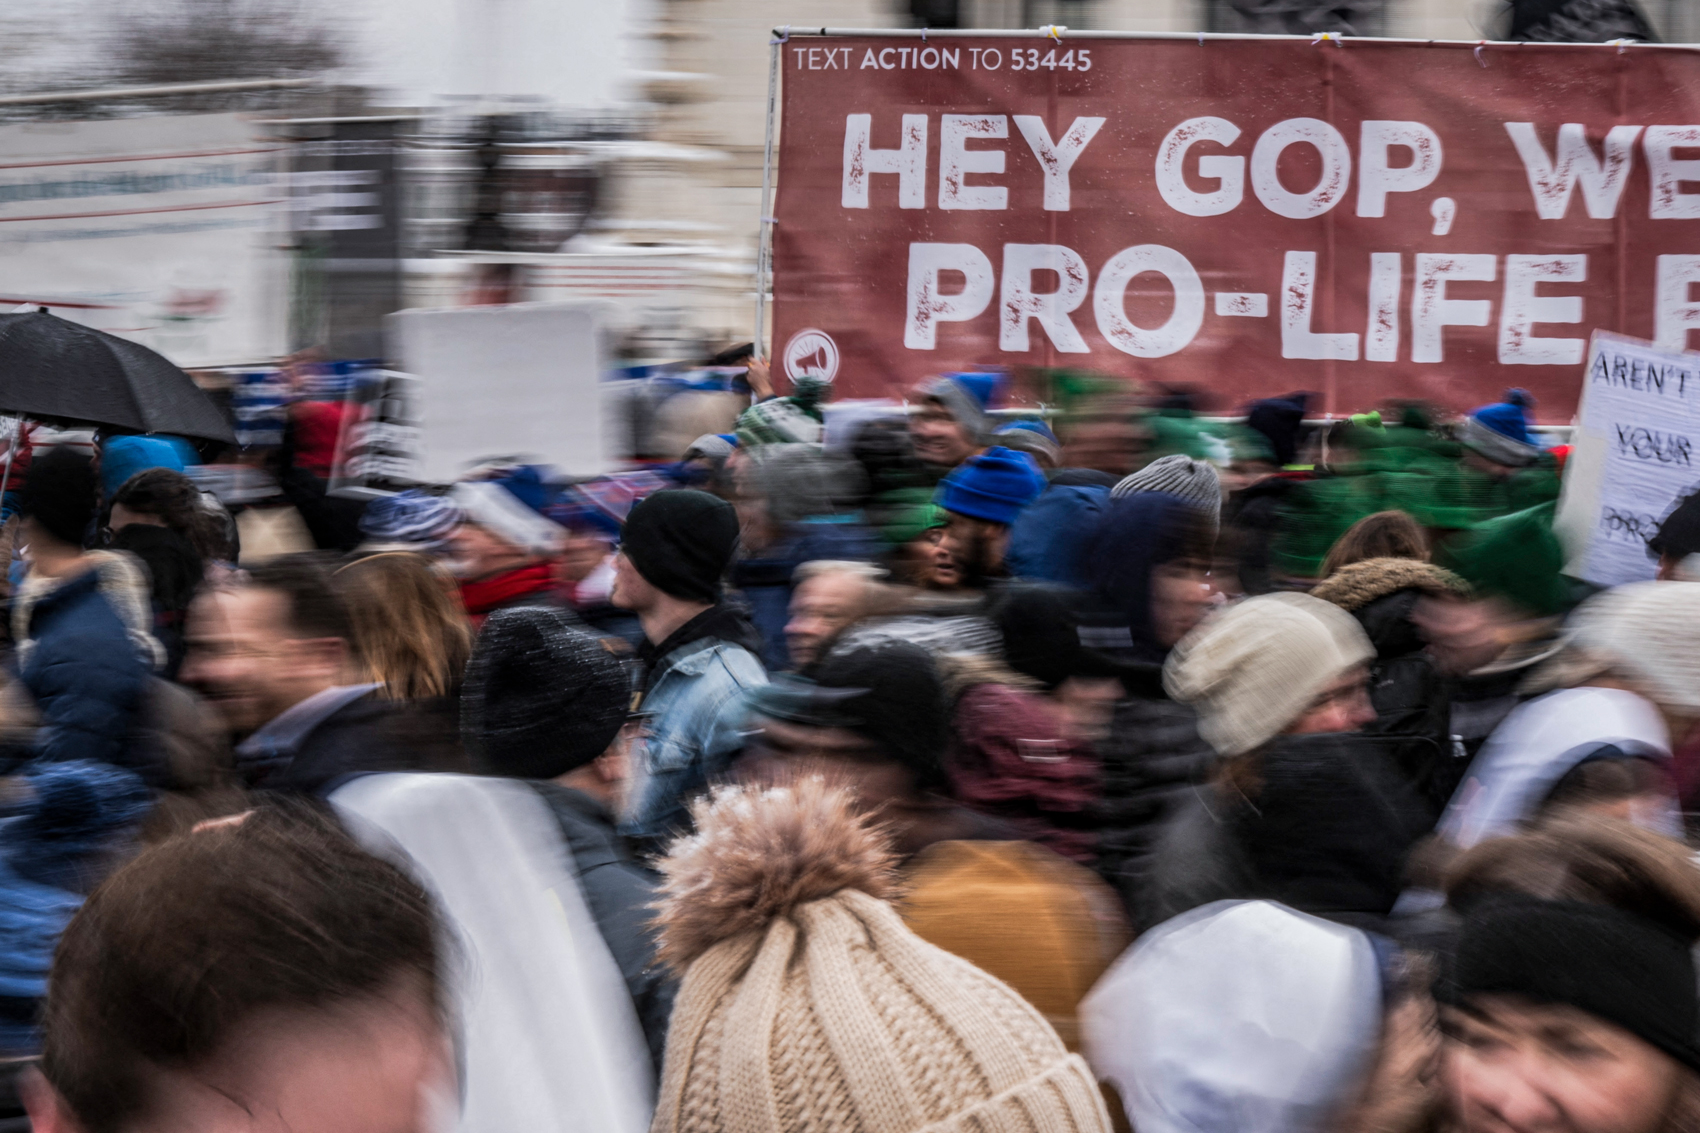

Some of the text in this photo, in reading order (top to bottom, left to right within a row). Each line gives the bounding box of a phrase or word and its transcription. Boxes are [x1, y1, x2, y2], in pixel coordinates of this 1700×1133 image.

[793, 47, 1092, 72] TEXT ACTION TO 53445
[841, 113, 1107, 212] HEY
[1155, 116, 1457, 236] GOP,
[904, 242, 1588, 366] PRO-LIFE
[1591, 350, 1691, 397] AREN'T
[1614, 422, 1692, 466] YOUR
